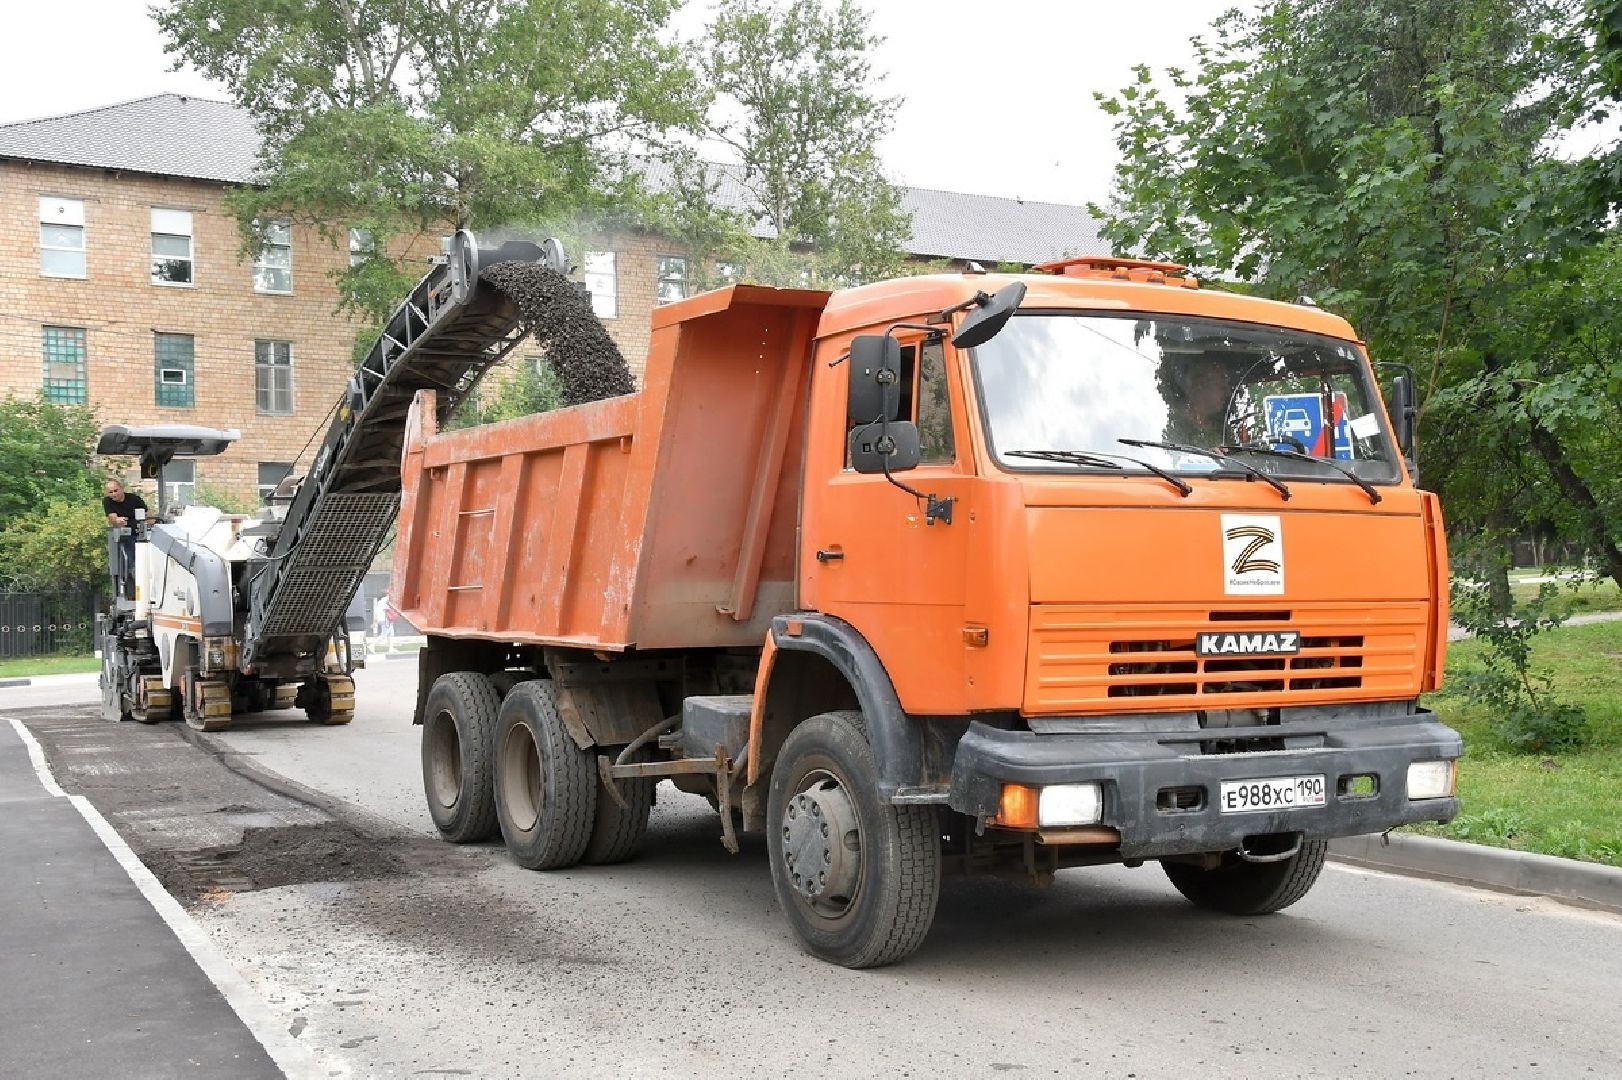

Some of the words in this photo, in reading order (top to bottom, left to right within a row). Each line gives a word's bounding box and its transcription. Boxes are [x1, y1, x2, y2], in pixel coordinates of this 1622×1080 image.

[1201, 633, 1297, 653] KAMAZ
[1227, 783, 1293, 808] Е988ХС
[1297, 779, 1321, 796] 190
